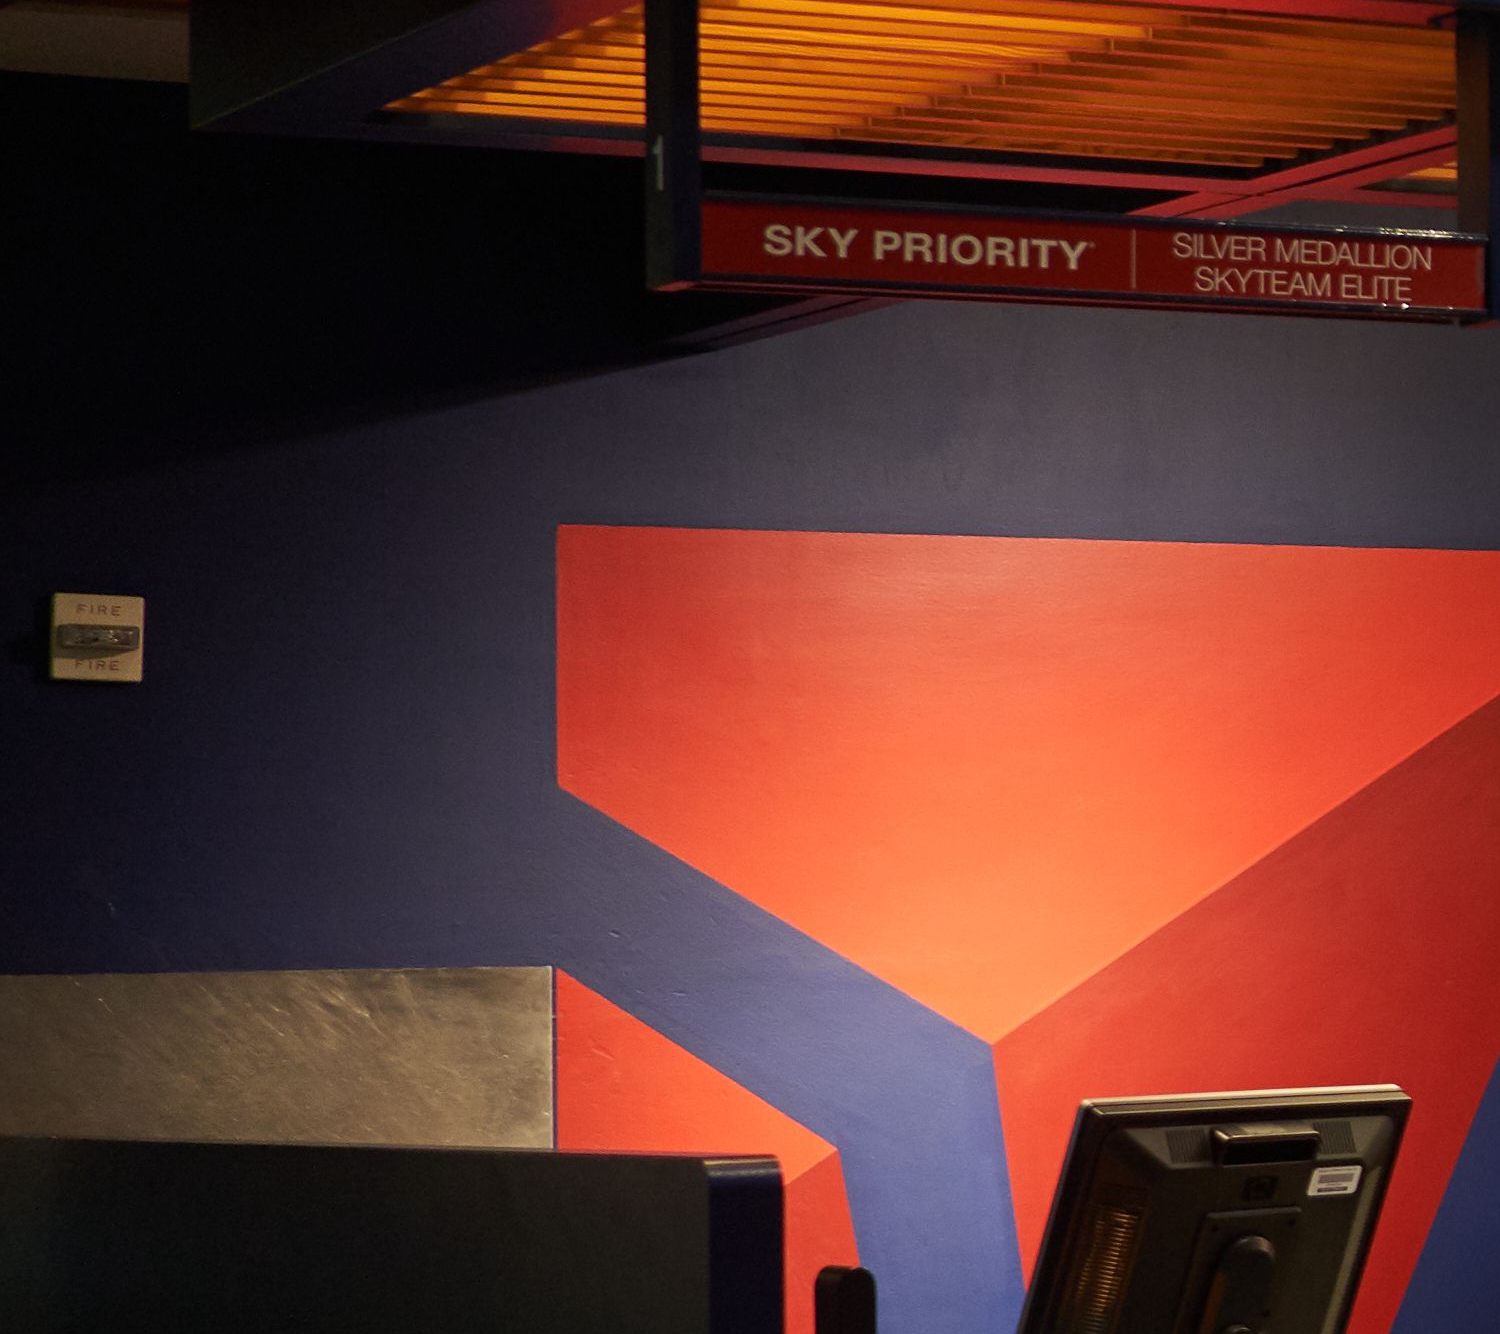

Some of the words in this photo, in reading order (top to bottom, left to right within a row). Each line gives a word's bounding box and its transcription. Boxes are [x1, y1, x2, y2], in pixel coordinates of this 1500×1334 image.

[652, 135, 664, 191] 1
[763, 224, 858, 259] SKY
[873, 230, 1088, 270] PRIORITY
[1172, 232, 1266, 262] SILVER
[1275, 237, 1432, 271] MEDALLION
[1194, 267, 1331, 298] SKYTEAM
[1341, 274, 1413, 302] ELITE
[76, 603, 121, 616] FIRE
[74, 660, 120, 671] FIRE
